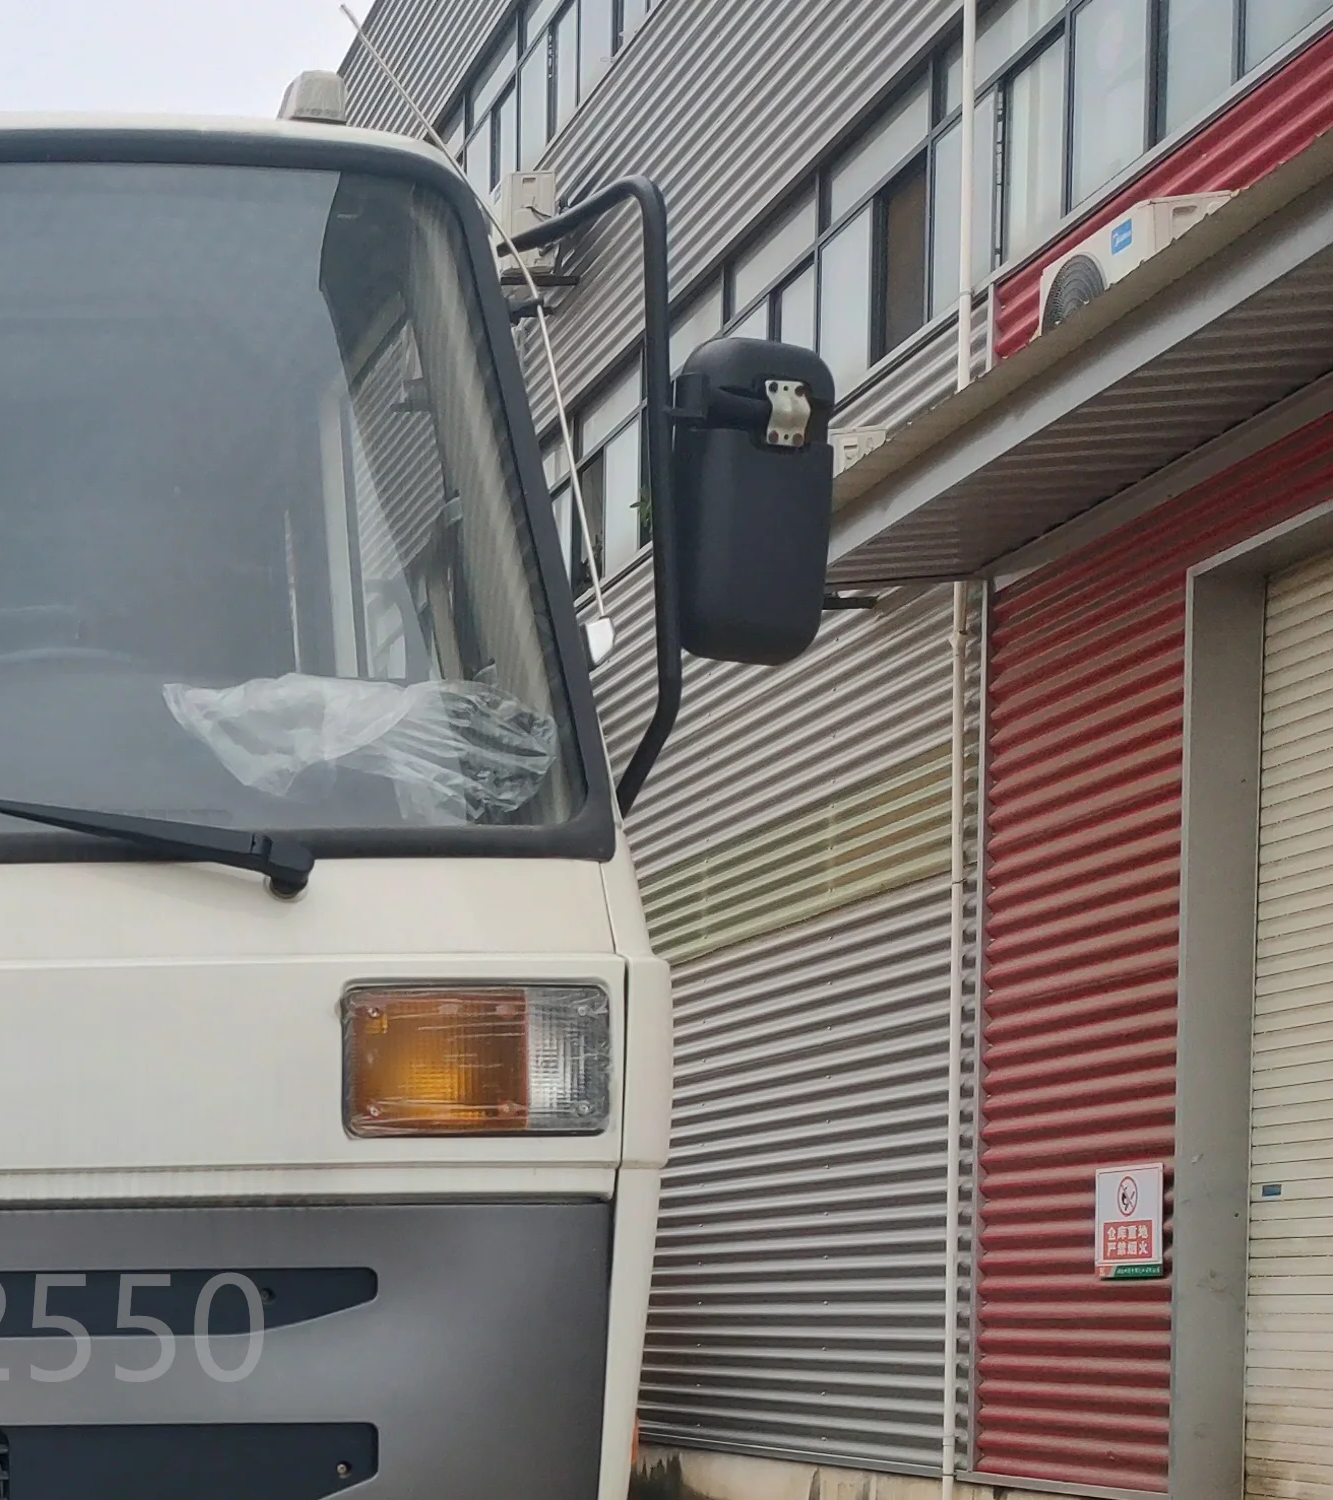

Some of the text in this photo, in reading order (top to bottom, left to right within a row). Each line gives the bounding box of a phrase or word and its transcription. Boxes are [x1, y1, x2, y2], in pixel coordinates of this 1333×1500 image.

[1107, 1225, 1149, 1240] 仓库重地
[1107, 1241, 1149, 1257] 严禁烟火
